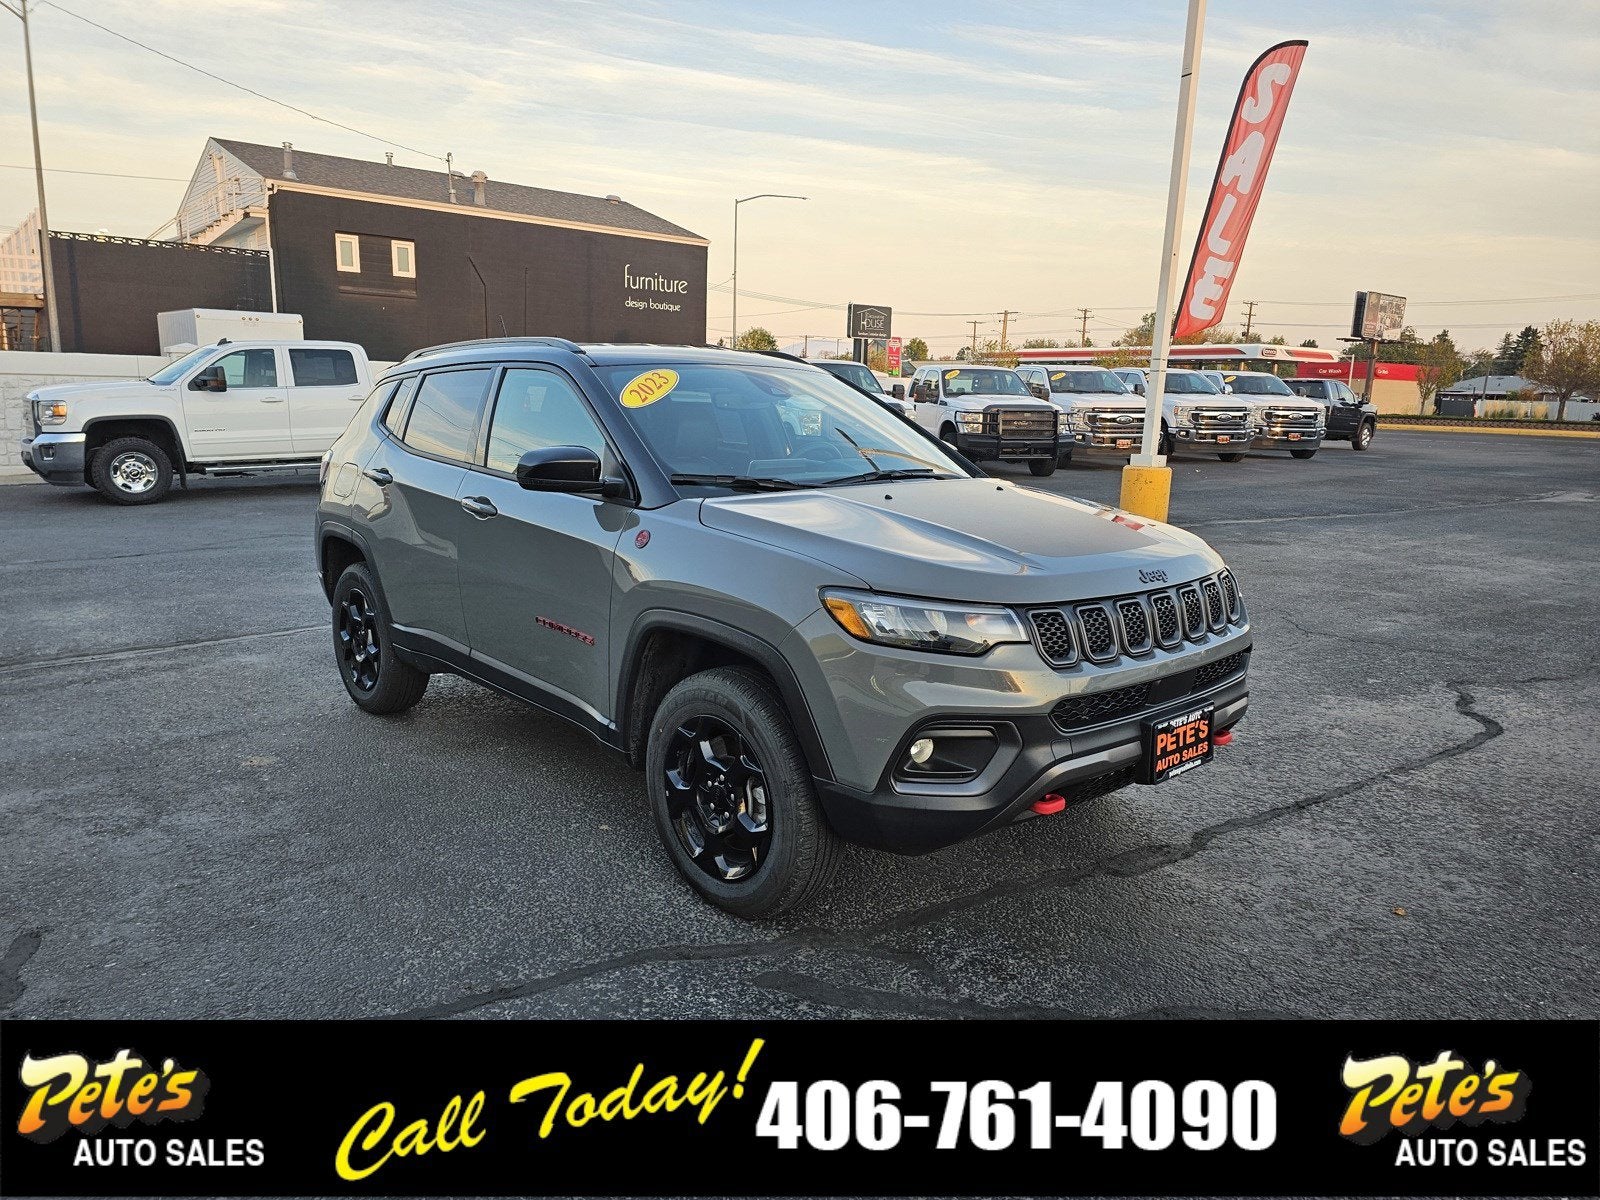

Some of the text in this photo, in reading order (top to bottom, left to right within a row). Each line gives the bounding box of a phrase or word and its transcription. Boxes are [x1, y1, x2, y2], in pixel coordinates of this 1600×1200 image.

[1189, 62, 1292, 321] SALE
[624, 263, 688, 294] furniture
[624, 296, 681, 313] design boutique
[860, 312, 885, 331] HOUSE
[629, 372, 669, 403] 2023
[1138, 569, 1169, 584] Jeep
[1157, 720, 1208, 755] PETE'S
[1156, 753, 1180, 772] AUTO
[1182, 742, 1208, 760] SALES
